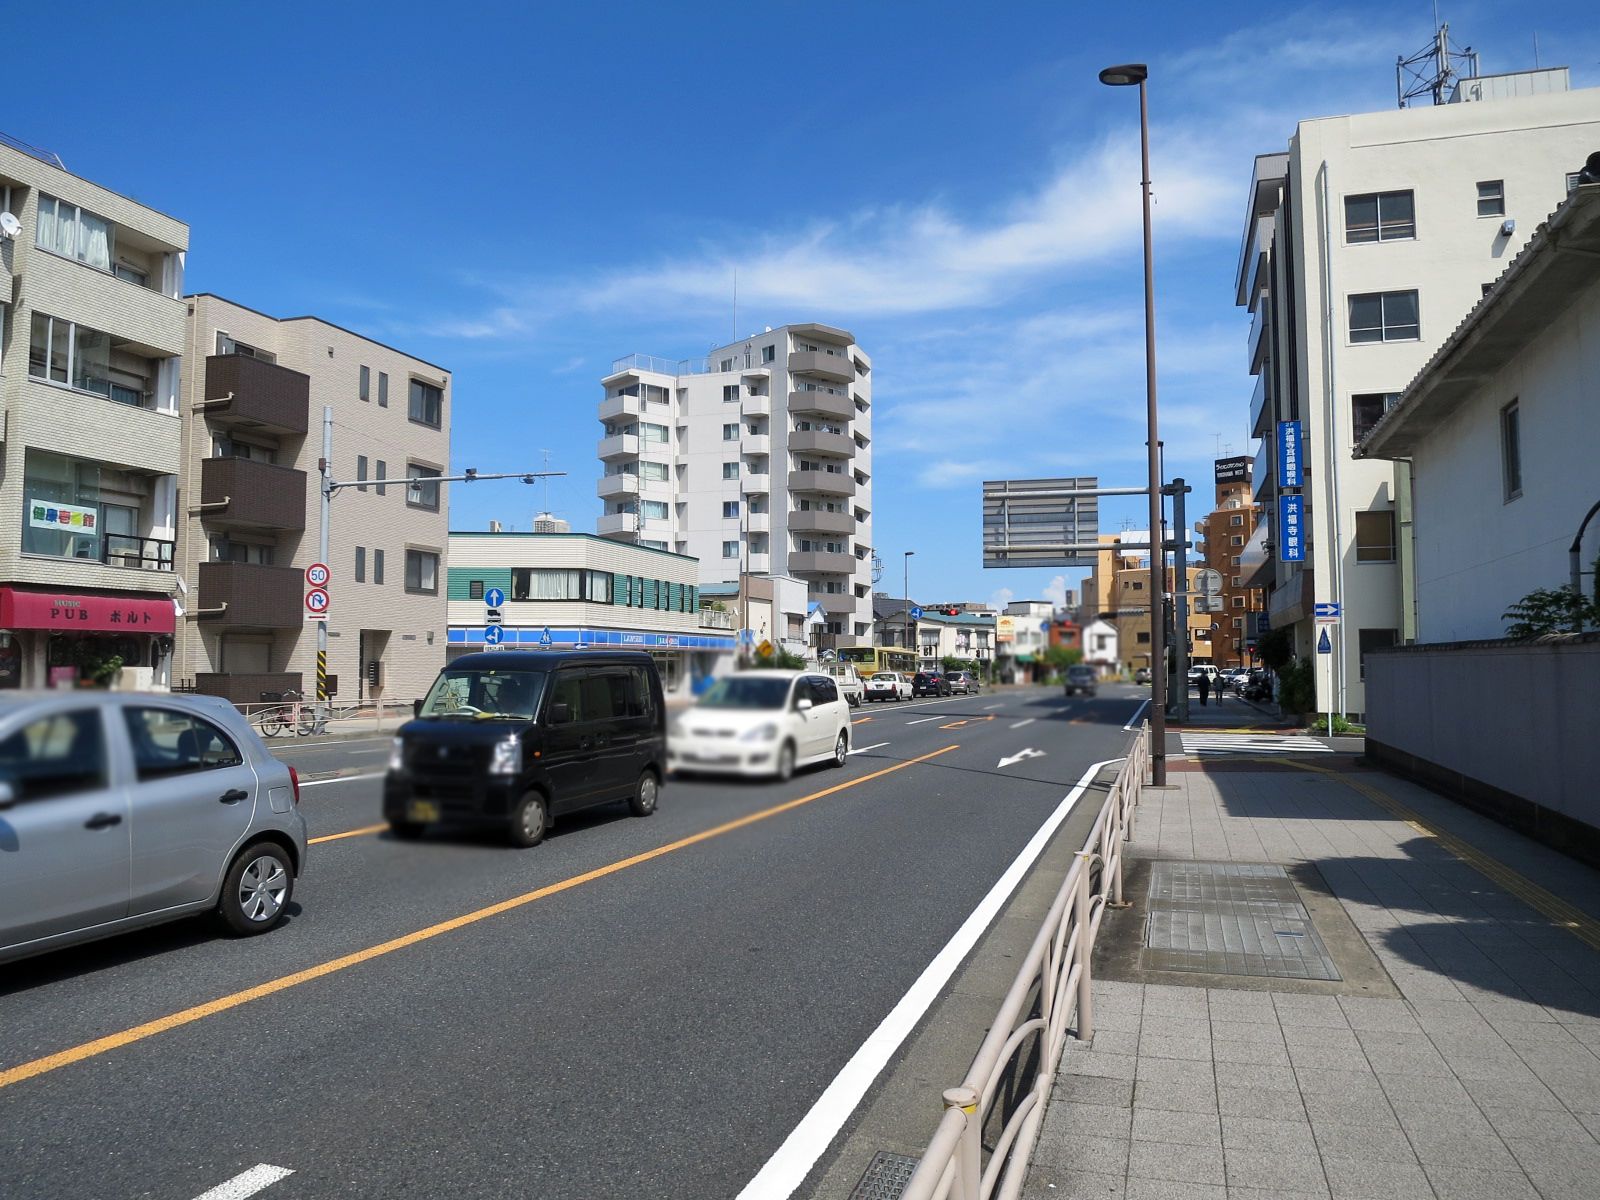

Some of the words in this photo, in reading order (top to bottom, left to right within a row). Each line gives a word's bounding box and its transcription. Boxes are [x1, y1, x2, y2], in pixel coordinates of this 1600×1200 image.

[1287, 503, 1298, 558] 洪福寺眼科
[311, 570, 325, 580] 50
[51, 608, 88, 620] PUB
[110, 610, 151, 624] ボルト
